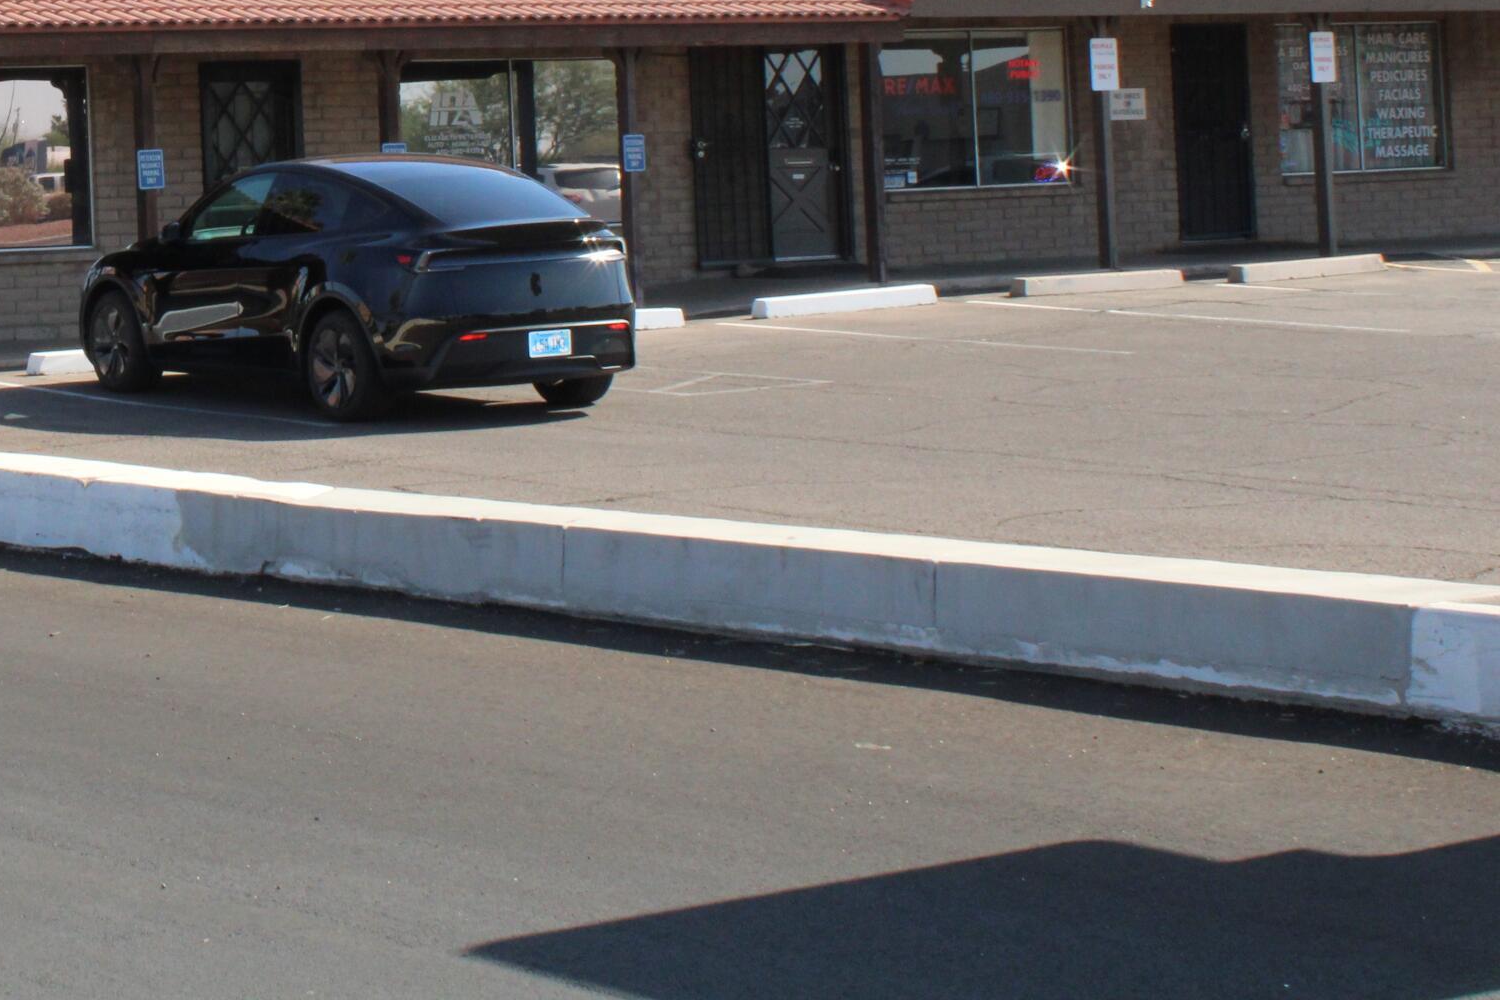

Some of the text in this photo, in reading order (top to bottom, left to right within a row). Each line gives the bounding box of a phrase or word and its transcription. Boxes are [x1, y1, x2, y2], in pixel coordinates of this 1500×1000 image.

[1367, 32, 1427, 44] HAIR CARE
[1366, 51, 1430, 63] MANICURES
[1370, 69, 1427, 81] PEDICURES
[884, 77, 956, 95] RE/MAX
[1379, 88, 1421, 100] FACIALS
[1377, 107, 1425, 119] WAXING
[1368, 126, 1438, 138] THERAPEUTIC
[1375, 145, 1429, 157] MASSAGE
